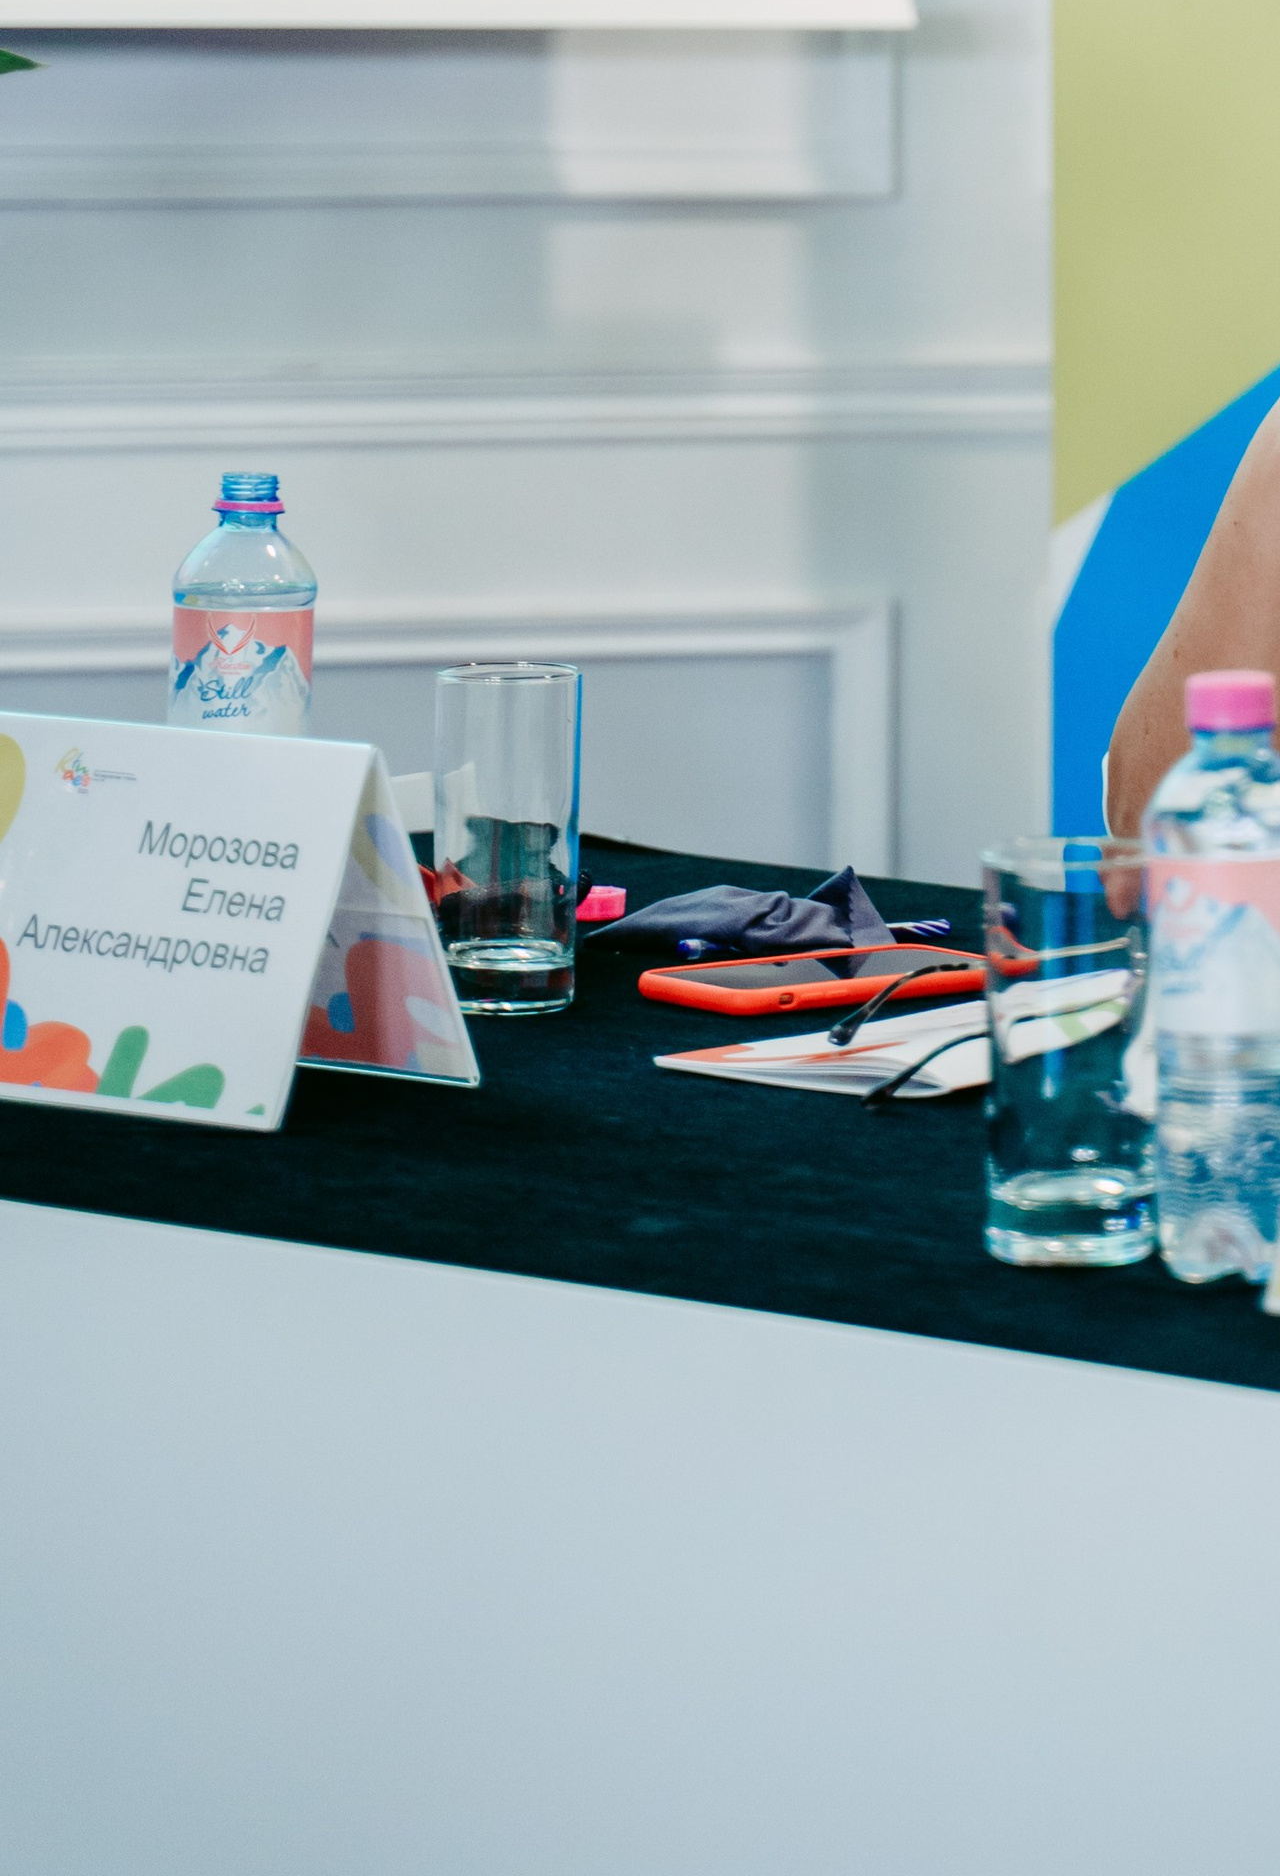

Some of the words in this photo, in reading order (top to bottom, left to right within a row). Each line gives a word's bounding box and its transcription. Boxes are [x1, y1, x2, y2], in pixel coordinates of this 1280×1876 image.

[199, 676, 252, 701] Still
[202, 702, 251, 720] water
[138, 820, 300, 870] Морозова
[181, 878, 286, 922] Елена
[17, 914, 270, 974] Александровна
